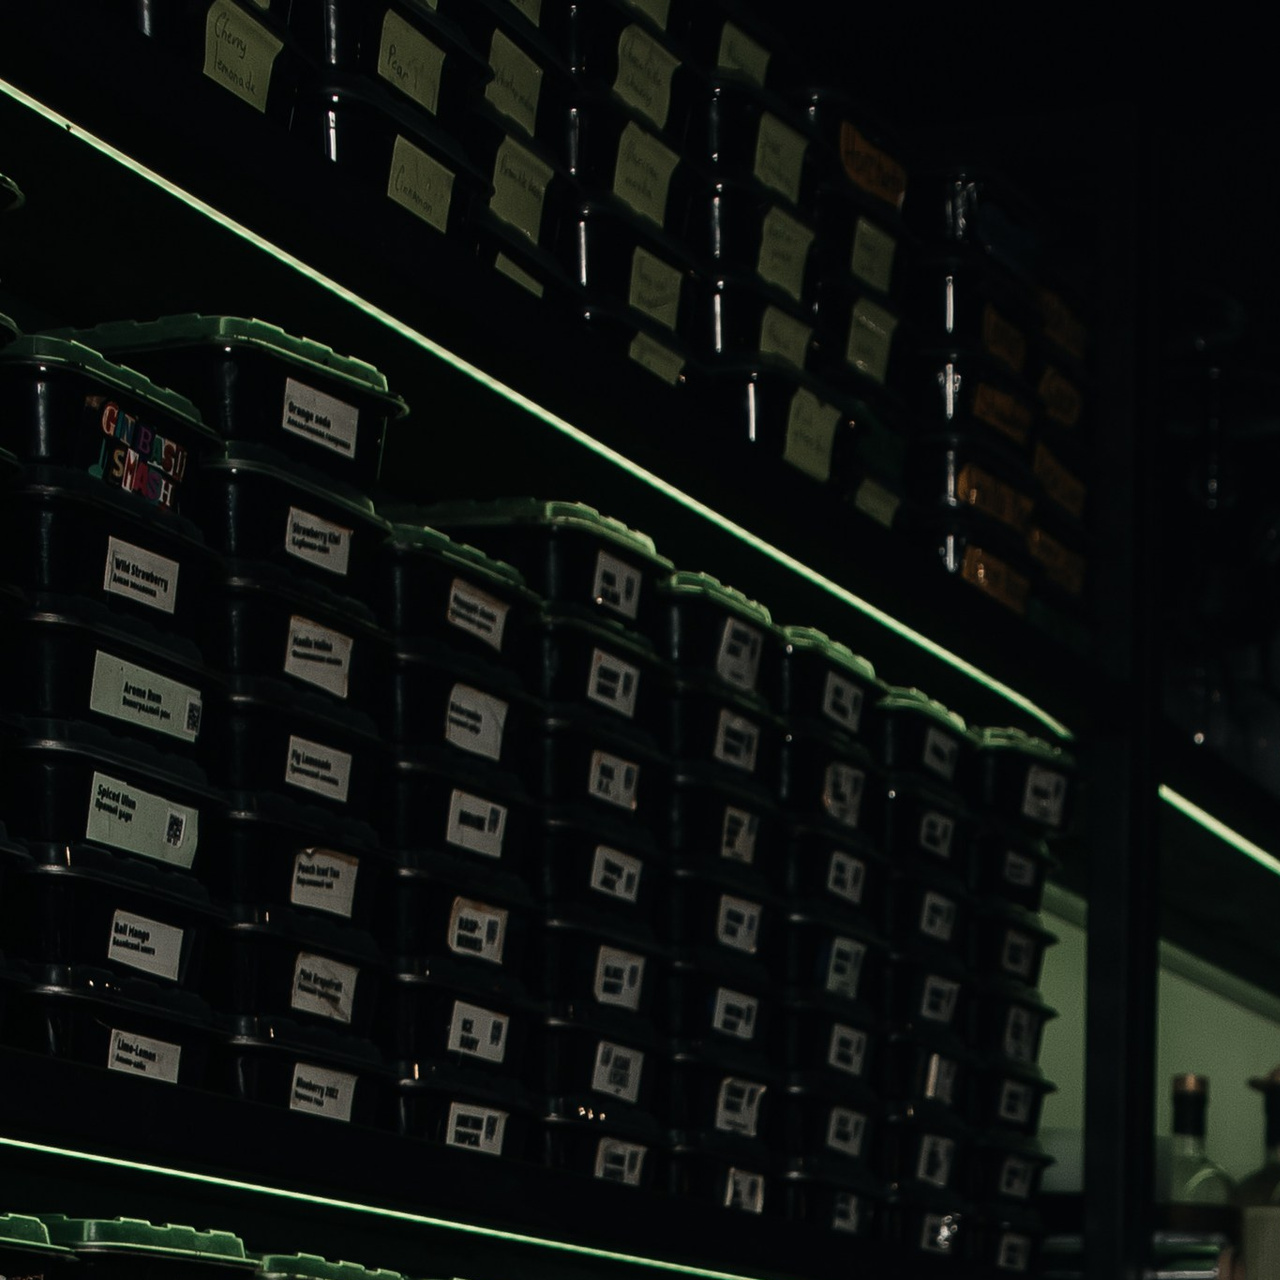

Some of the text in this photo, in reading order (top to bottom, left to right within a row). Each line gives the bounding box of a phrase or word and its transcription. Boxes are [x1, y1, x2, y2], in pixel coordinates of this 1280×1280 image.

[214, 12, 247, 59] Cherry
[214, 40, 257, 95] lemonade
[388, 44, 410, 81] Pear
[395, 165, 433, 214] Cinnamon
[102, 401, 136, 447] GIN
[288, 400, 314, 423] Orange
[112, 449, 173, 506] SMASH
[292, 522, 328, 545] Strawberry
[115, 557, 169, 593] Wild Strawberry
[97, 784, 121, 806] Spiced
[114, 921, 150, 944] Bali Mango
[117, 1038, 157, 1062] Lime-Lemon
